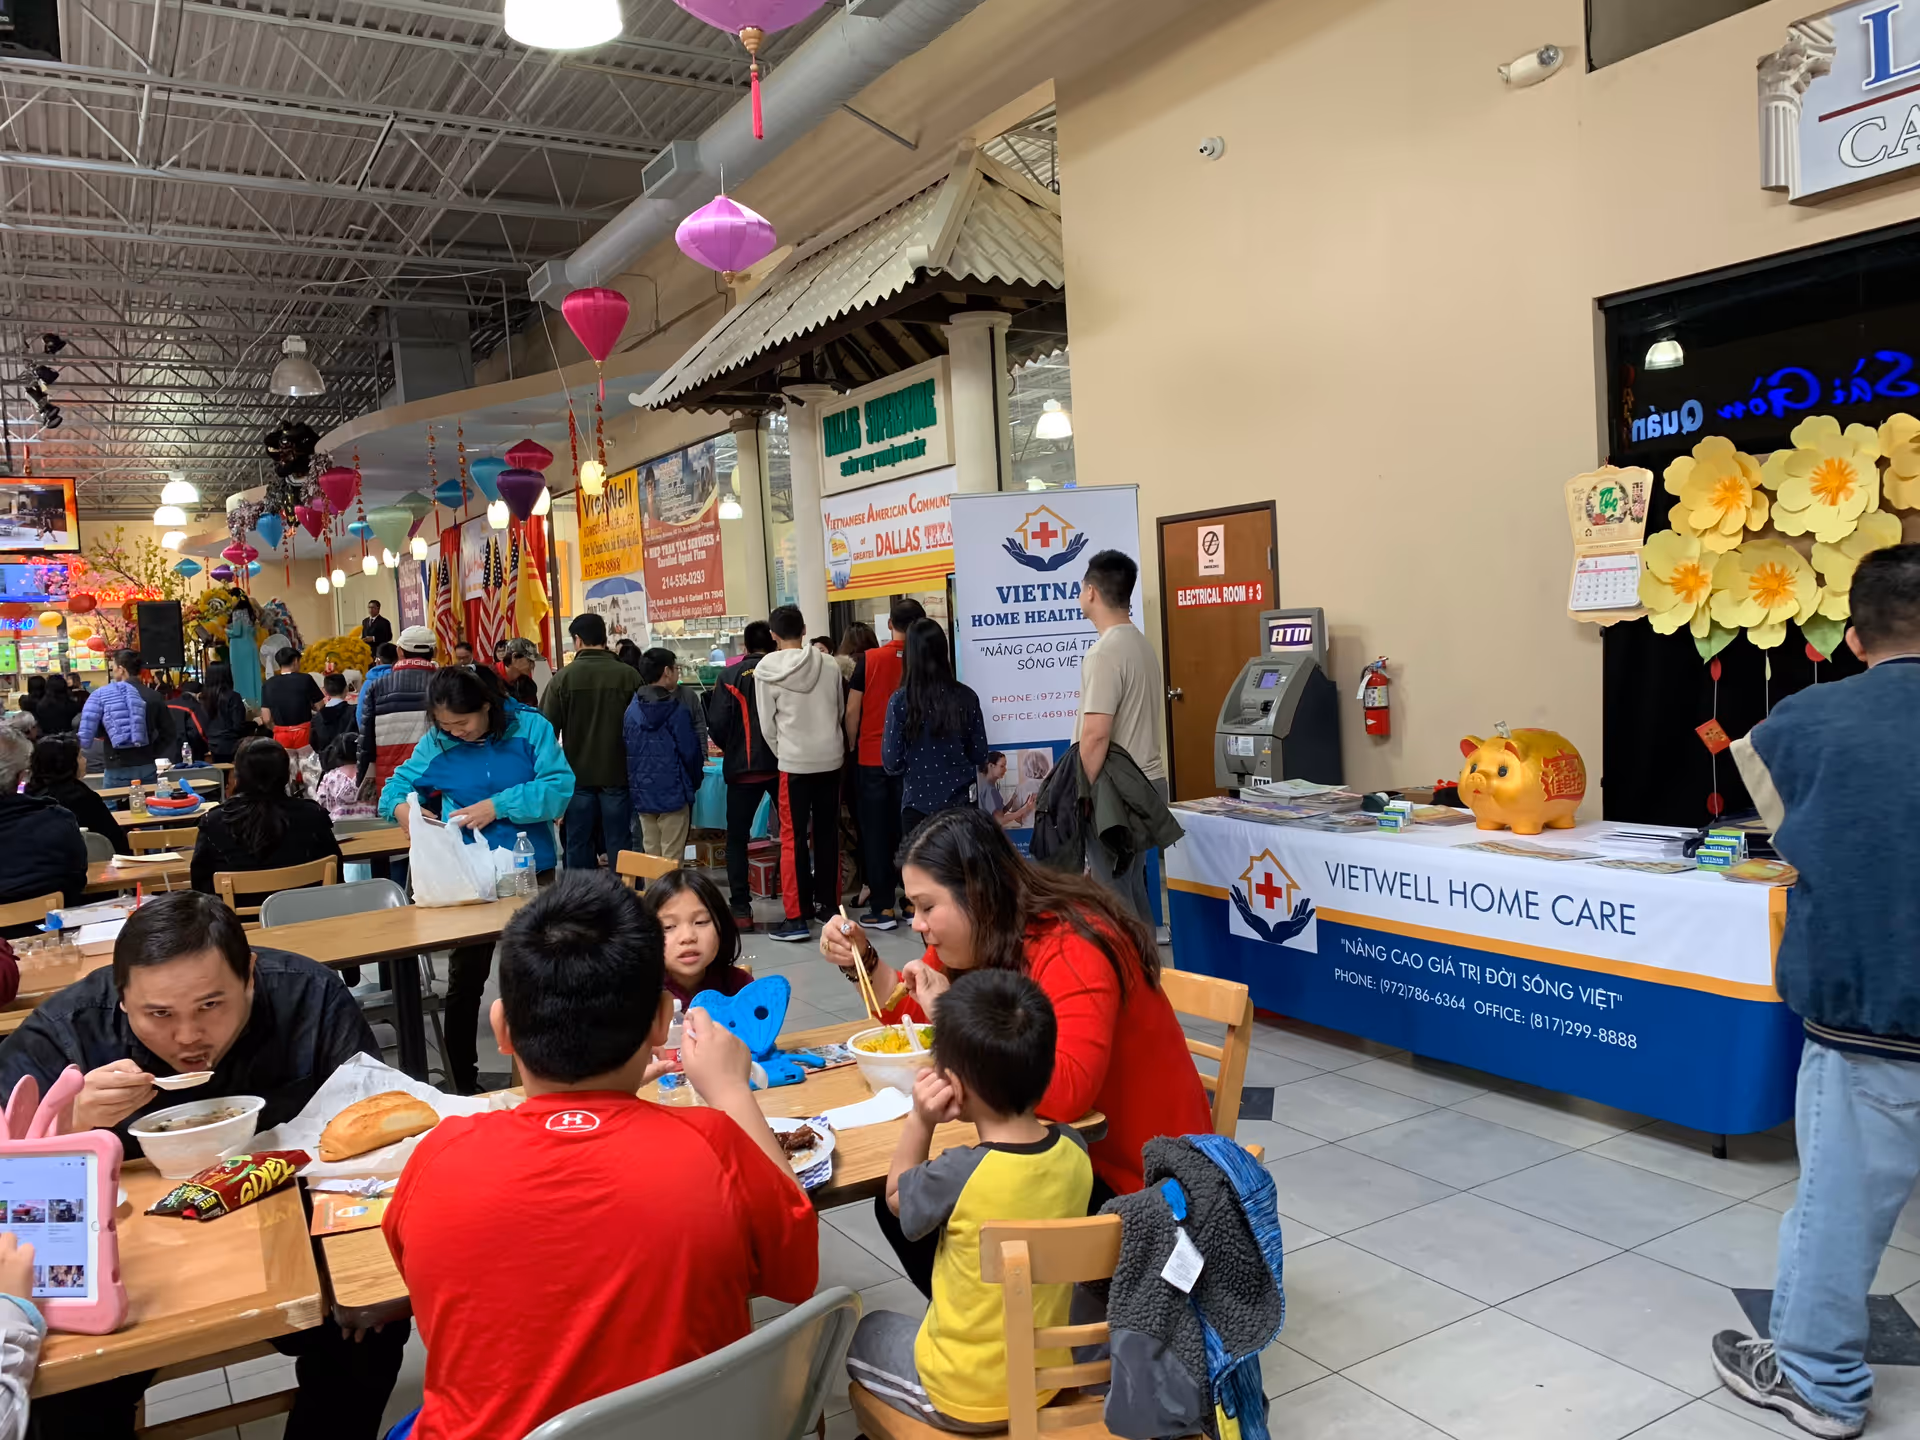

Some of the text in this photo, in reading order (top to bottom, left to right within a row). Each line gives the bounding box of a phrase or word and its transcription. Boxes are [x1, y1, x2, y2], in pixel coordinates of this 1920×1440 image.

[867, 503, 908, 523] AMERICAN
[704, 591, 710, 600] TX
[1177, 587, 1222, 607] ELECTRICAL
[1222, 584, 1247, 603] ROOM
[1256, 583, 1262, 601] 3
[971, 612, 1021, 627] HOME
[1271, 627, 1311, 643] ATM
[1026, 642, 1053, 655] CAO
[1056, 638, 1078, 653] GIÁ
[1324, 860, 1637, 935] VIETWELL HOME CARE
[1341, 937, 1387, 961] "NÂNG
[1391, 949, 1424, 970] CAO
[1428, 955, 1456, 977] GIÁ
[1459, 962, 1481, 985] TRỊ
[1485, 966, 1517, 989] ĐỜI
[1334, 967, 1638, 1049] PHONE: (972)786-6364 OFFICE: (817)299-8888
